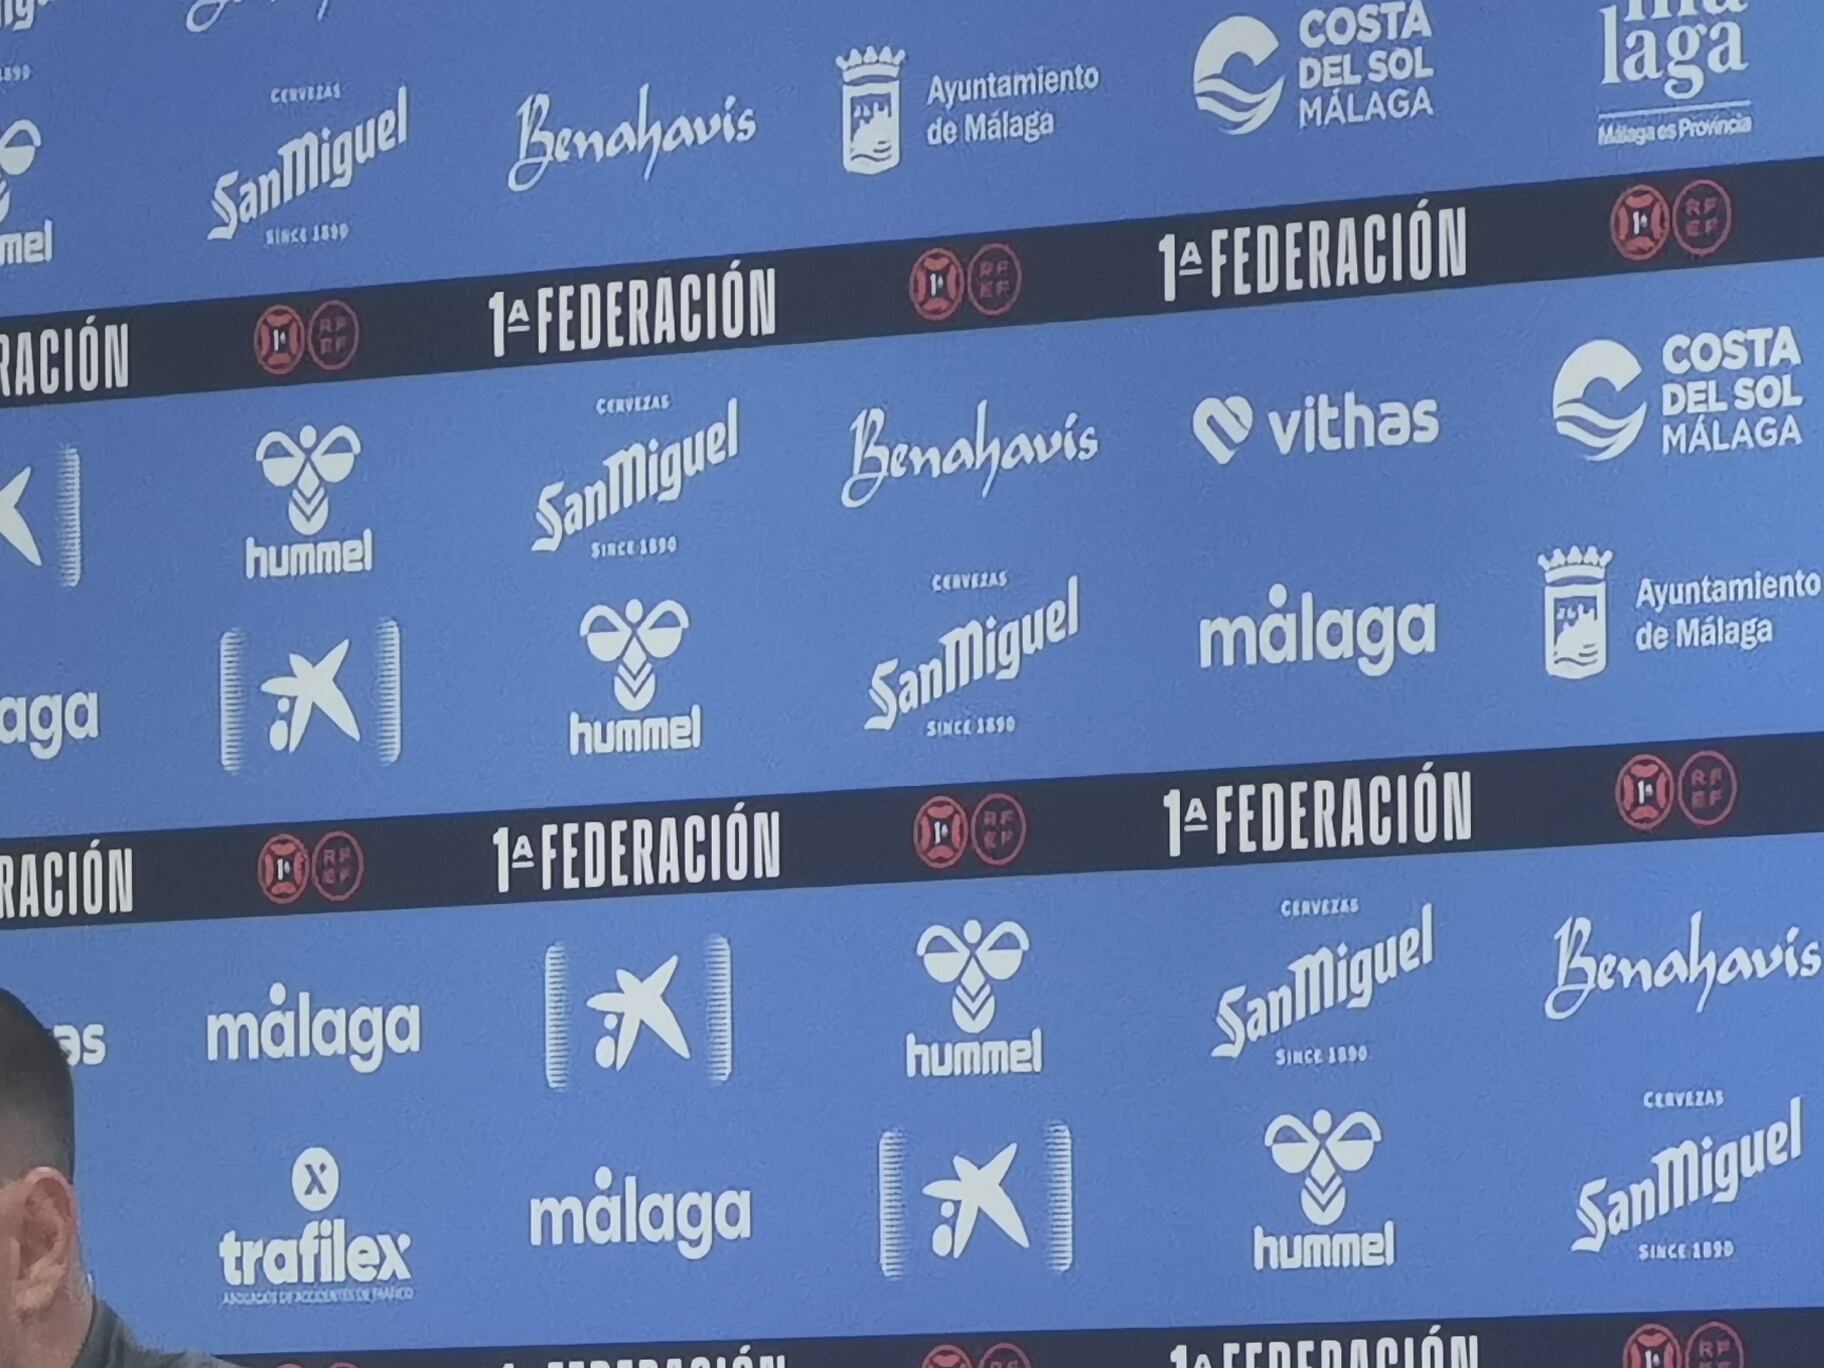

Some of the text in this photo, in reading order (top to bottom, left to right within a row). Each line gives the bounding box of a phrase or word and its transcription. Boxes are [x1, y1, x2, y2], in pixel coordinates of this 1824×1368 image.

[1300, 0, 1431, 48] COSTA
[1299, 47, 1433, 88] DEL SOL
[1601, 4, 1748, 99] laga
[927, 65, 1098, 104] Ayuntamiento
[1300, 87, 1433, 128] MÁLAGA
[508, 84, 756, 191] Benahavís
[927, 110, 1053, 144] de Málaga
[1212, 199, 1466, 297] FEDERACIÓN
[538, 260, 775, 353] FEDERACIÓN
[1663, 326, 1801, 374] COSTA
[1663, 375, 1802, 415] DEL SOL
[1268, 392, 1439, 454] vithas
[1663, 415, 1802, 454] MÁLAGA
[841, 400, 1097, 507] Benahavís
[246, 529, 372, 578] hummel
[1637, 570, 1821, 611] Ayuntamiento
[1636, 616, 1772, 650] de Málaga
[570, 705, 700, 755] hummel
[1217, 762, 1471, 854] FEDERACIÓN
[542, 802, 779, 890] FEDERACIÓN
[1545, 911, 1821, 1019] Benahavís
[907, 1028, 1041, 1077] hummel
[219, 1219, 410, 1285] trafilex
[1255, 1221, 1394, 1269] hummel
